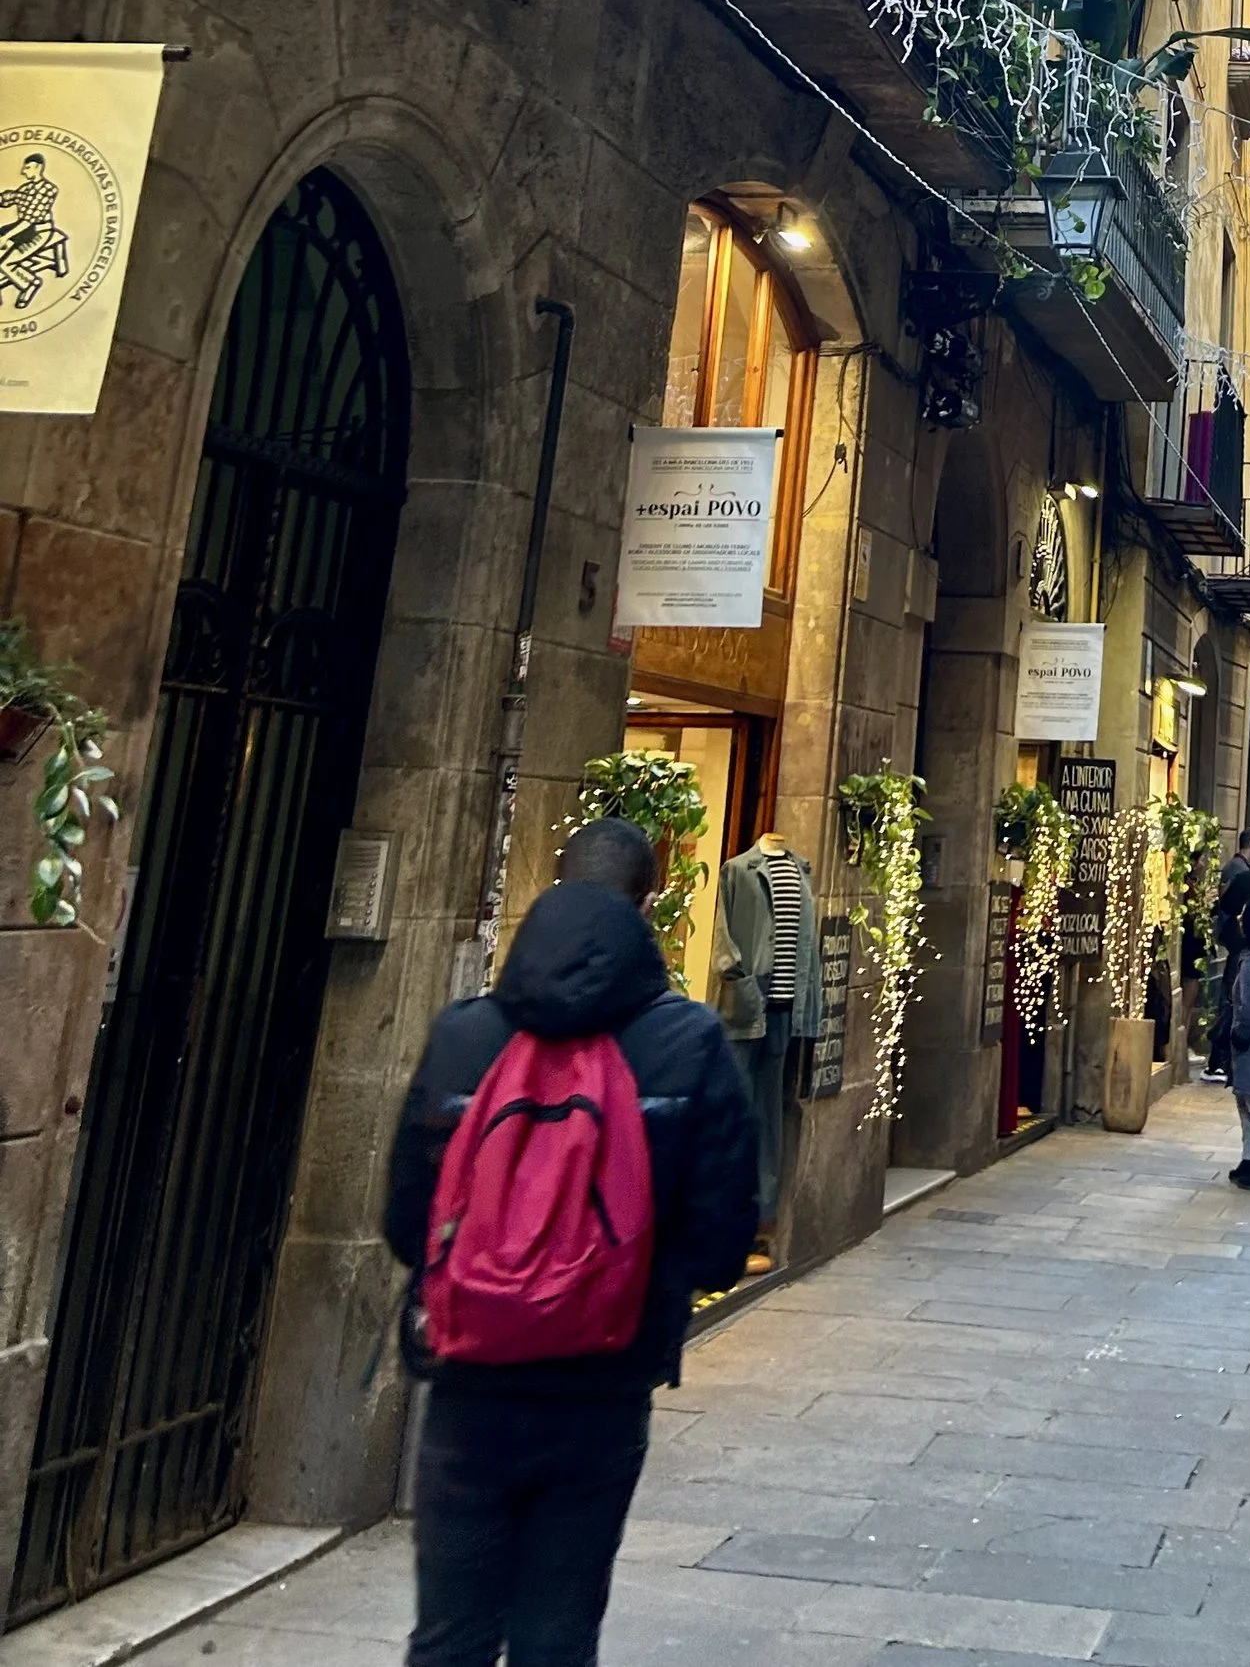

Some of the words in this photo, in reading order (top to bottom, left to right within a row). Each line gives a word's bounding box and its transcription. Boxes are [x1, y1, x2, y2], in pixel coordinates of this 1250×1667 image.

[23, 130, 43, 141] DE
[44, 130, 114, 191] ALPARGATAS
[105, 191, 118, 213] DE
[70, 216, 118, 302] BARCELONA
[3, 320, 37, 339] 1940
[707, 499, 761, 517] POVO
[1027, 667, 1057, 679] espai
[1061, 667, 1092, 678] POVO
[1062, 765, 1070, 787] A
[1081, 838, 1108, 862] ARCS
